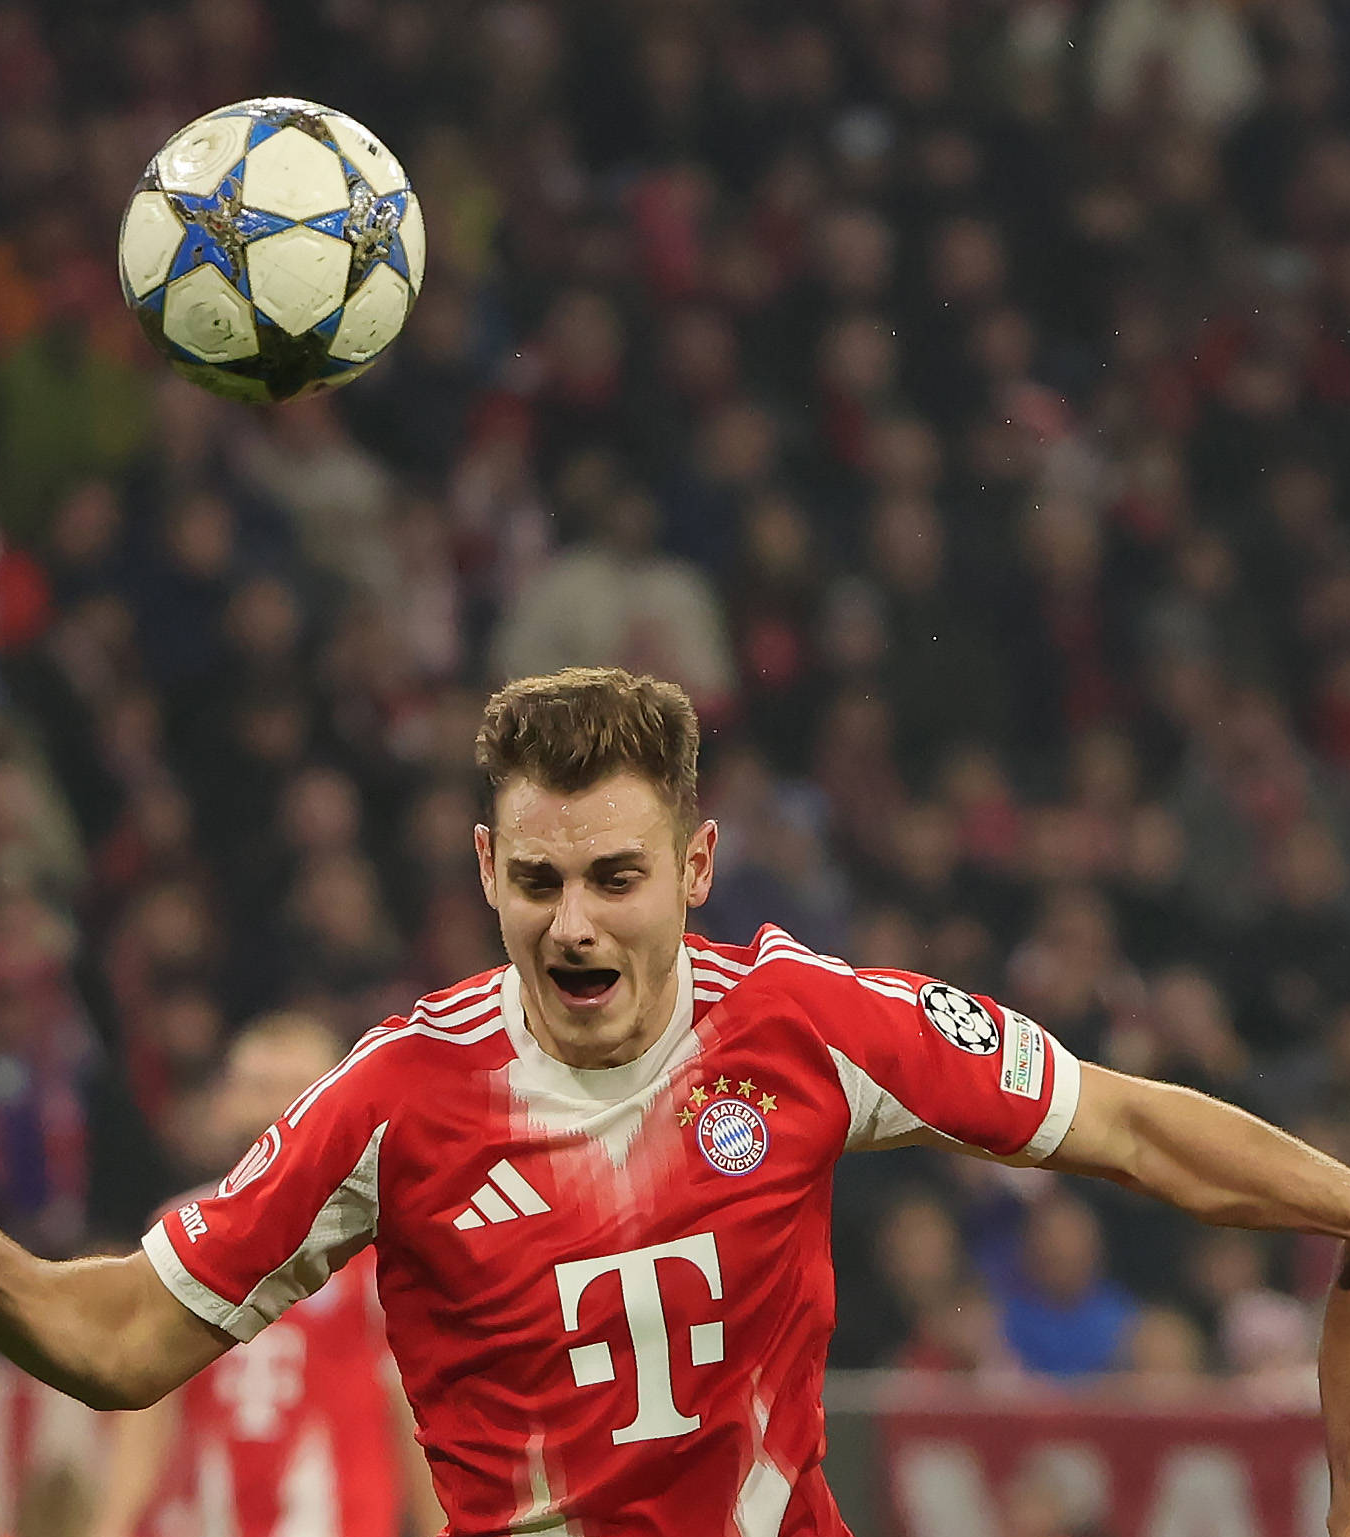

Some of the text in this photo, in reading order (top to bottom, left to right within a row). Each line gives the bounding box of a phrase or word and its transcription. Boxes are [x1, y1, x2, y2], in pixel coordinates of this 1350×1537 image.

[702, 1104, 759, 1136] FC BAYERN
[554, 1231, 725, 1446] T
